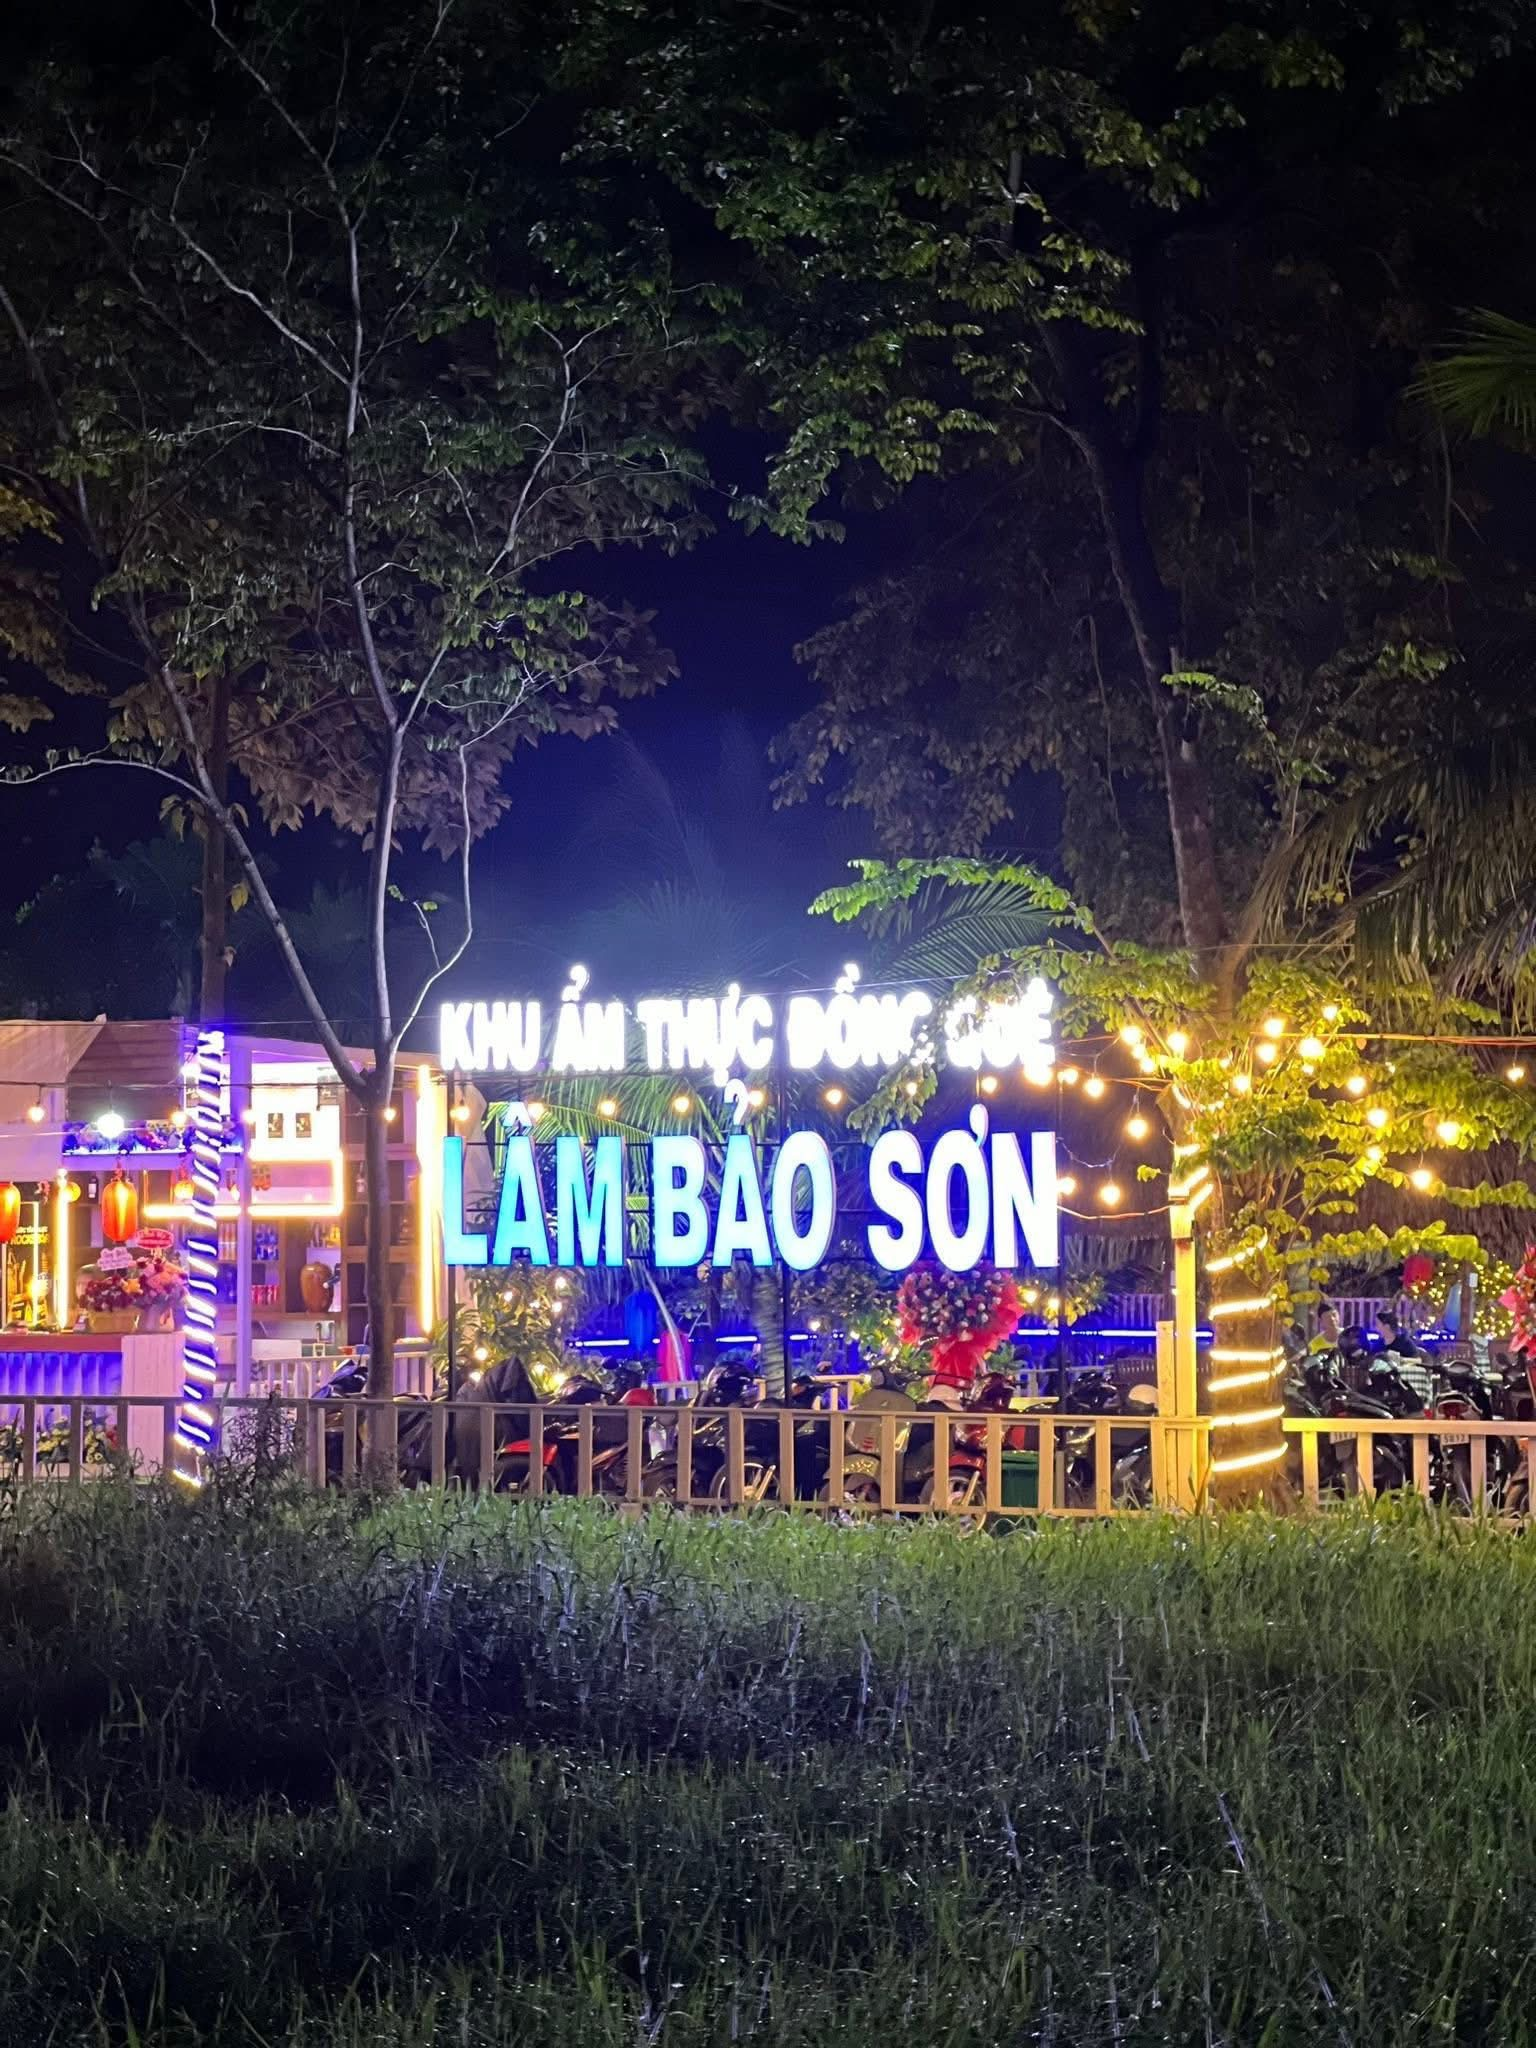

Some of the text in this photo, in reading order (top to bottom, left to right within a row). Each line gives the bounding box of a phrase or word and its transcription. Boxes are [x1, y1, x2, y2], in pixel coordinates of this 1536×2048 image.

[440, 1001, 541, 1071] KHU
[552, 965, 626, 1071] ẨM
[637, 983, 774, 1087] THỰC
[442, 1078, 1060, 1273] LÂM BẢO SƠN
